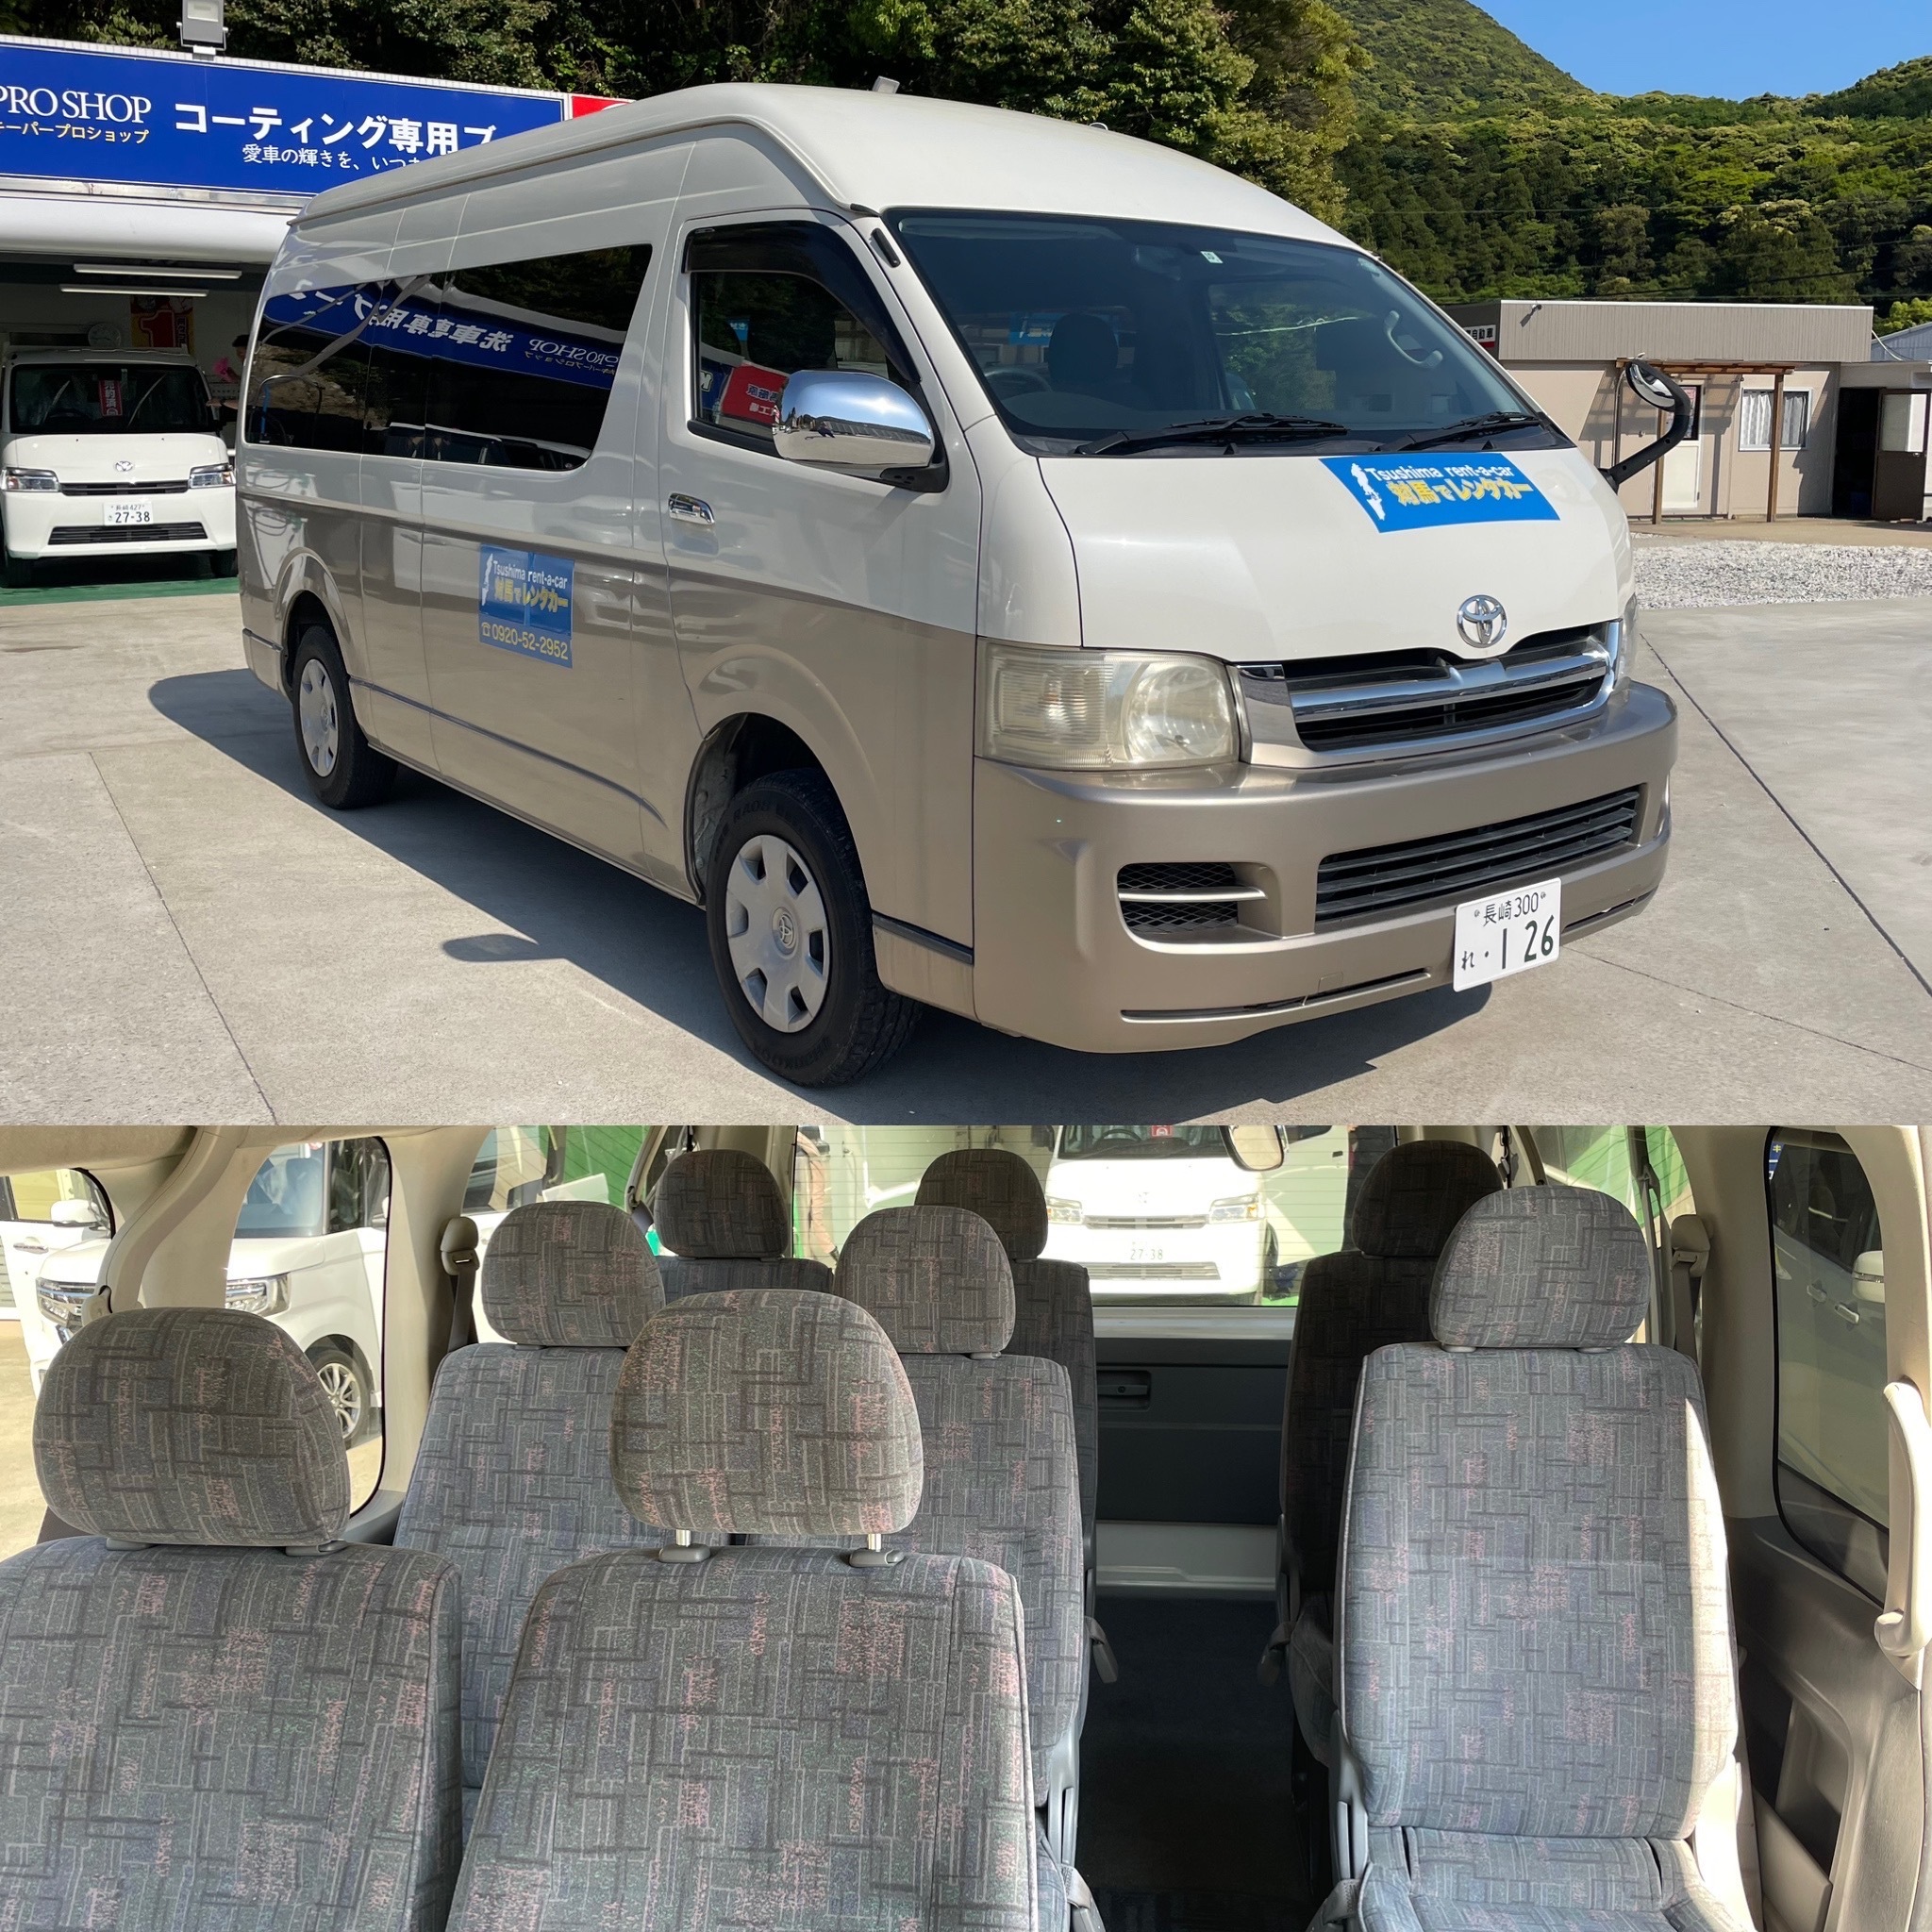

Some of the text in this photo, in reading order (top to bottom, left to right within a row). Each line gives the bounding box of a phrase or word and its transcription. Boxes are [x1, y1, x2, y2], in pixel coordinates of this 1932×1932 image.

[62, 91, 152, 123] SHOP
[1364, 464, 1514, 482] Tsushima rent-a-car
[1386, 476, 1534, 507] 対馬でレンタカー
[115, 510, 150, 524] 27-38
[492, 559, 568, 590] Tsushima rent-a-car
[491, 624, 569, 660] 0920-52-2952
[1483, 891, 1539, 927] 長崎300
